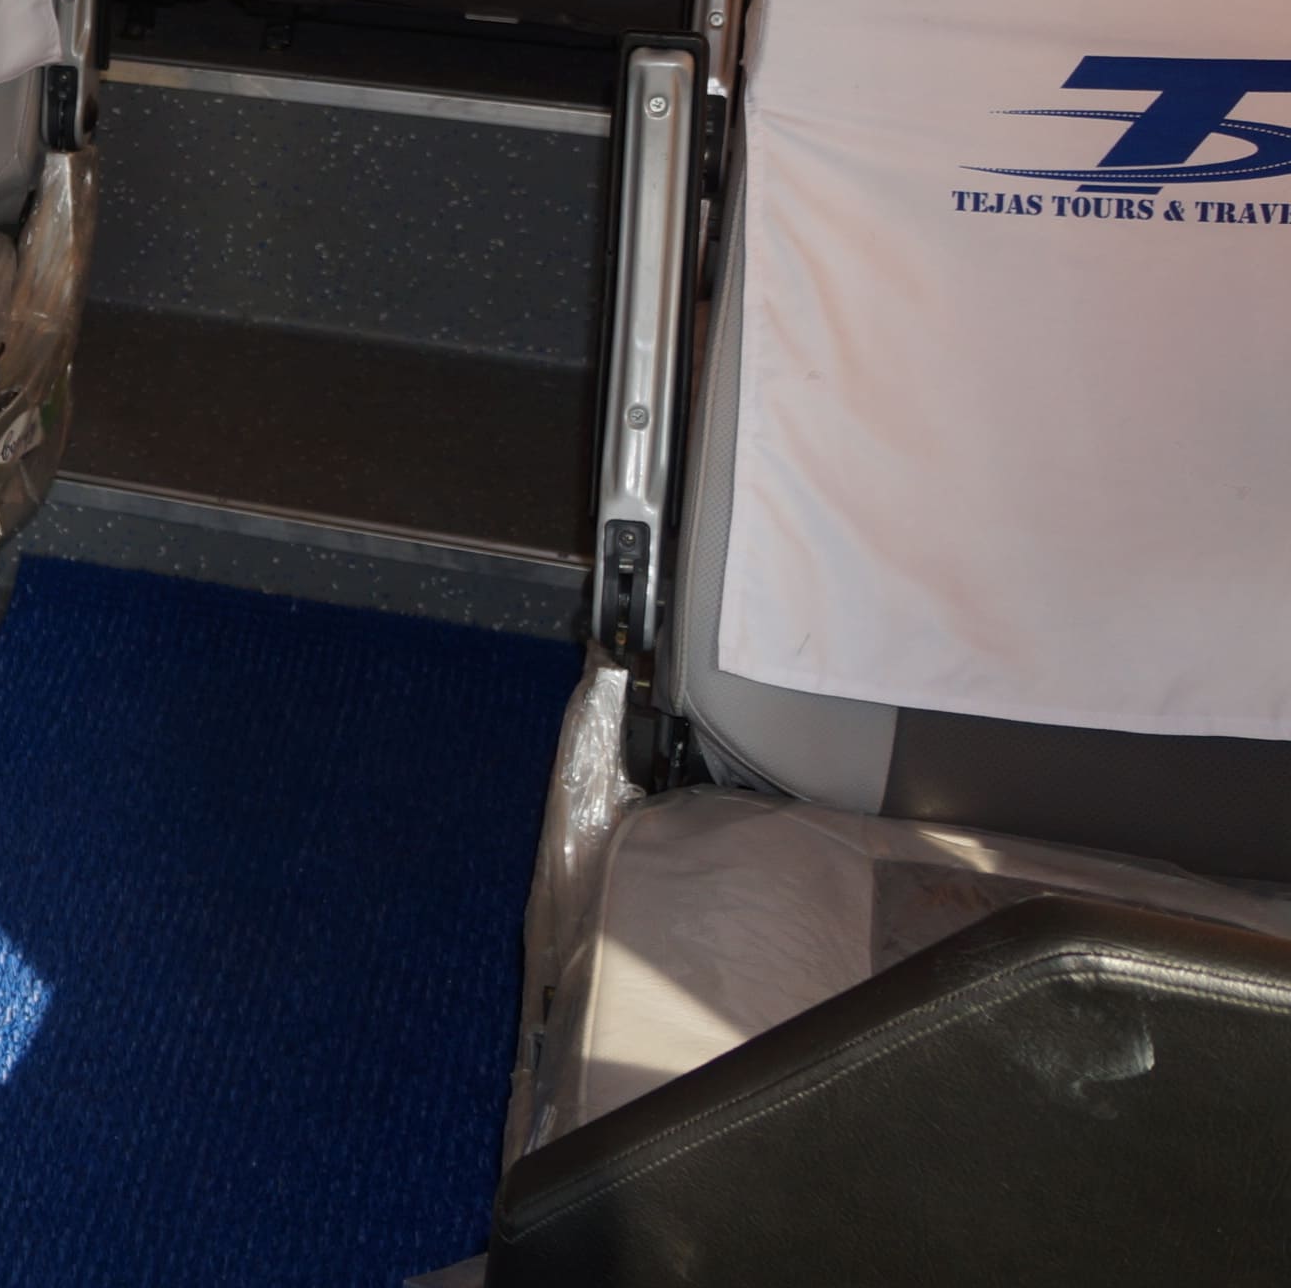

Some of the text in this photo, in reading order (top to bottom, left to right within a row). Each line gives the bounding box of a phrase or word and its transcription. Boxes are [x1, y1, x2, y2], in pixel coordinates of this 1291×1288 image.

[952, 190, 1043, 216] TEJAS
[1051, 195, 1154, 221] TOURS
[1162, 199, 1185, 222] &
